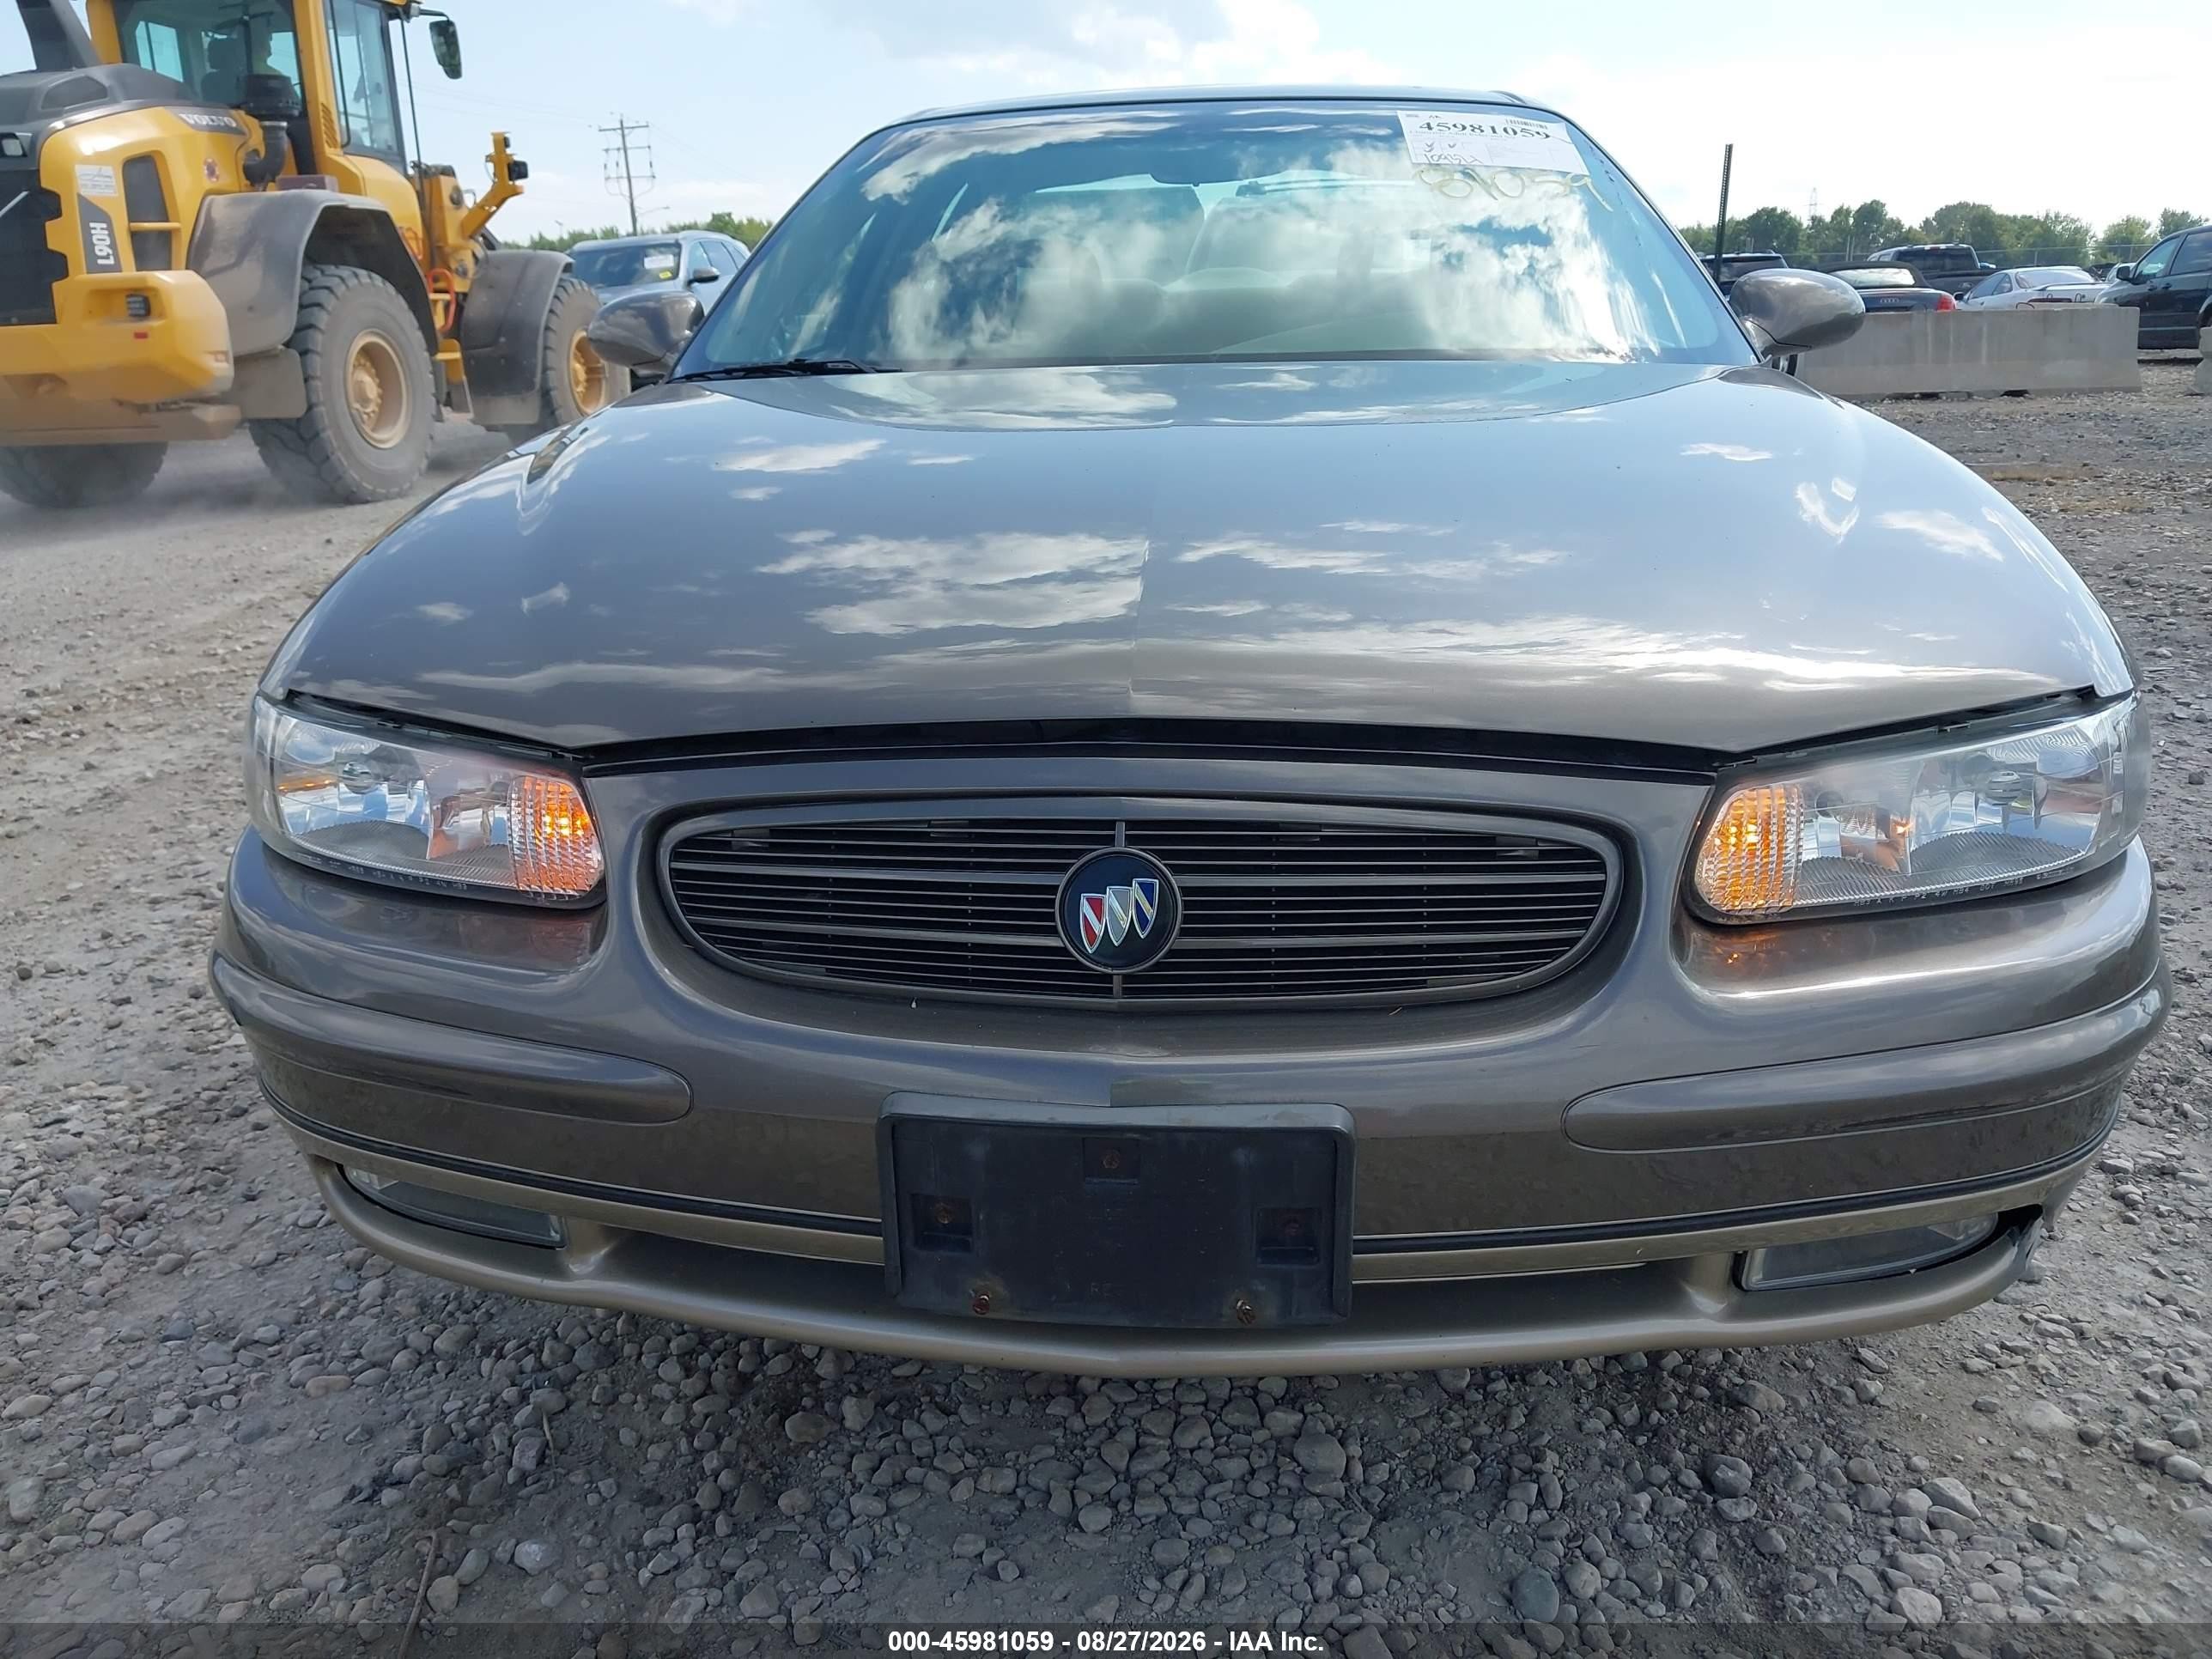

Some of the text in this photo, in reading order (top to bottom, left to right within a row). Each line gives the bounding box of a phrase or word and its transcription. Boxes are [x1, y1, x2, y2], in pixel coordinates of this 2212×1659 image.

[179, 113, 237, 128] VOLVO
[1419, 121, 1551, 139] 45981059
[88, 222, 115, 264] L90H
